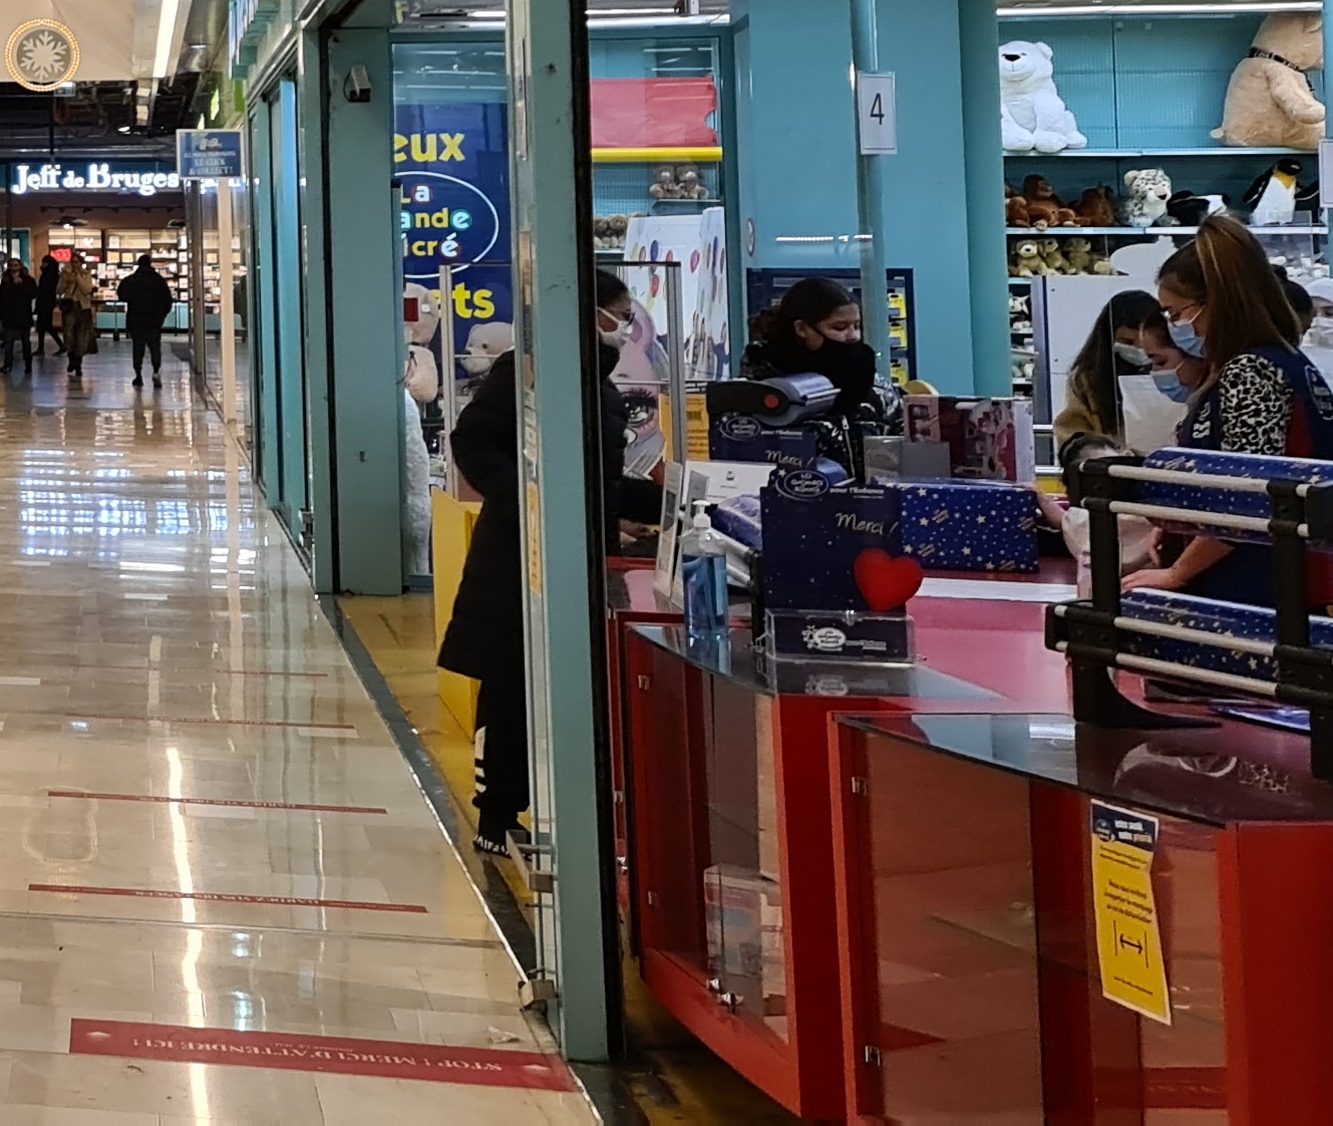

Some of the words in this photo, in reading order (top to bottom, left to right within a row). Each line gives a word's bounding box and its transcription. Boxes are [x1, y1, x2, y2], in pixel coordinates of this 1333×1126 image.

[869, 91, 886, 126] 4
[393, 131, 467, 163] eux
[10, 164, 62, 194] Jeff
[63, 170, 85, 188] de
[85, 163, 181, 196] Bruges
[400, 207, 472, 230] ande
[402, 232, 460, 258] cré
[766, 449, 803, 468] Merci
[835, 512, 884, 536] Merci
[886, 521, 900, 538] !
[142, 1038, 175, 1048] ICI
[177, 1041, 332, 1059] D'ATTENDRE
[335, 1052, 417, 1066] MERCI
[437, 1058, 503, 1072] STOP
